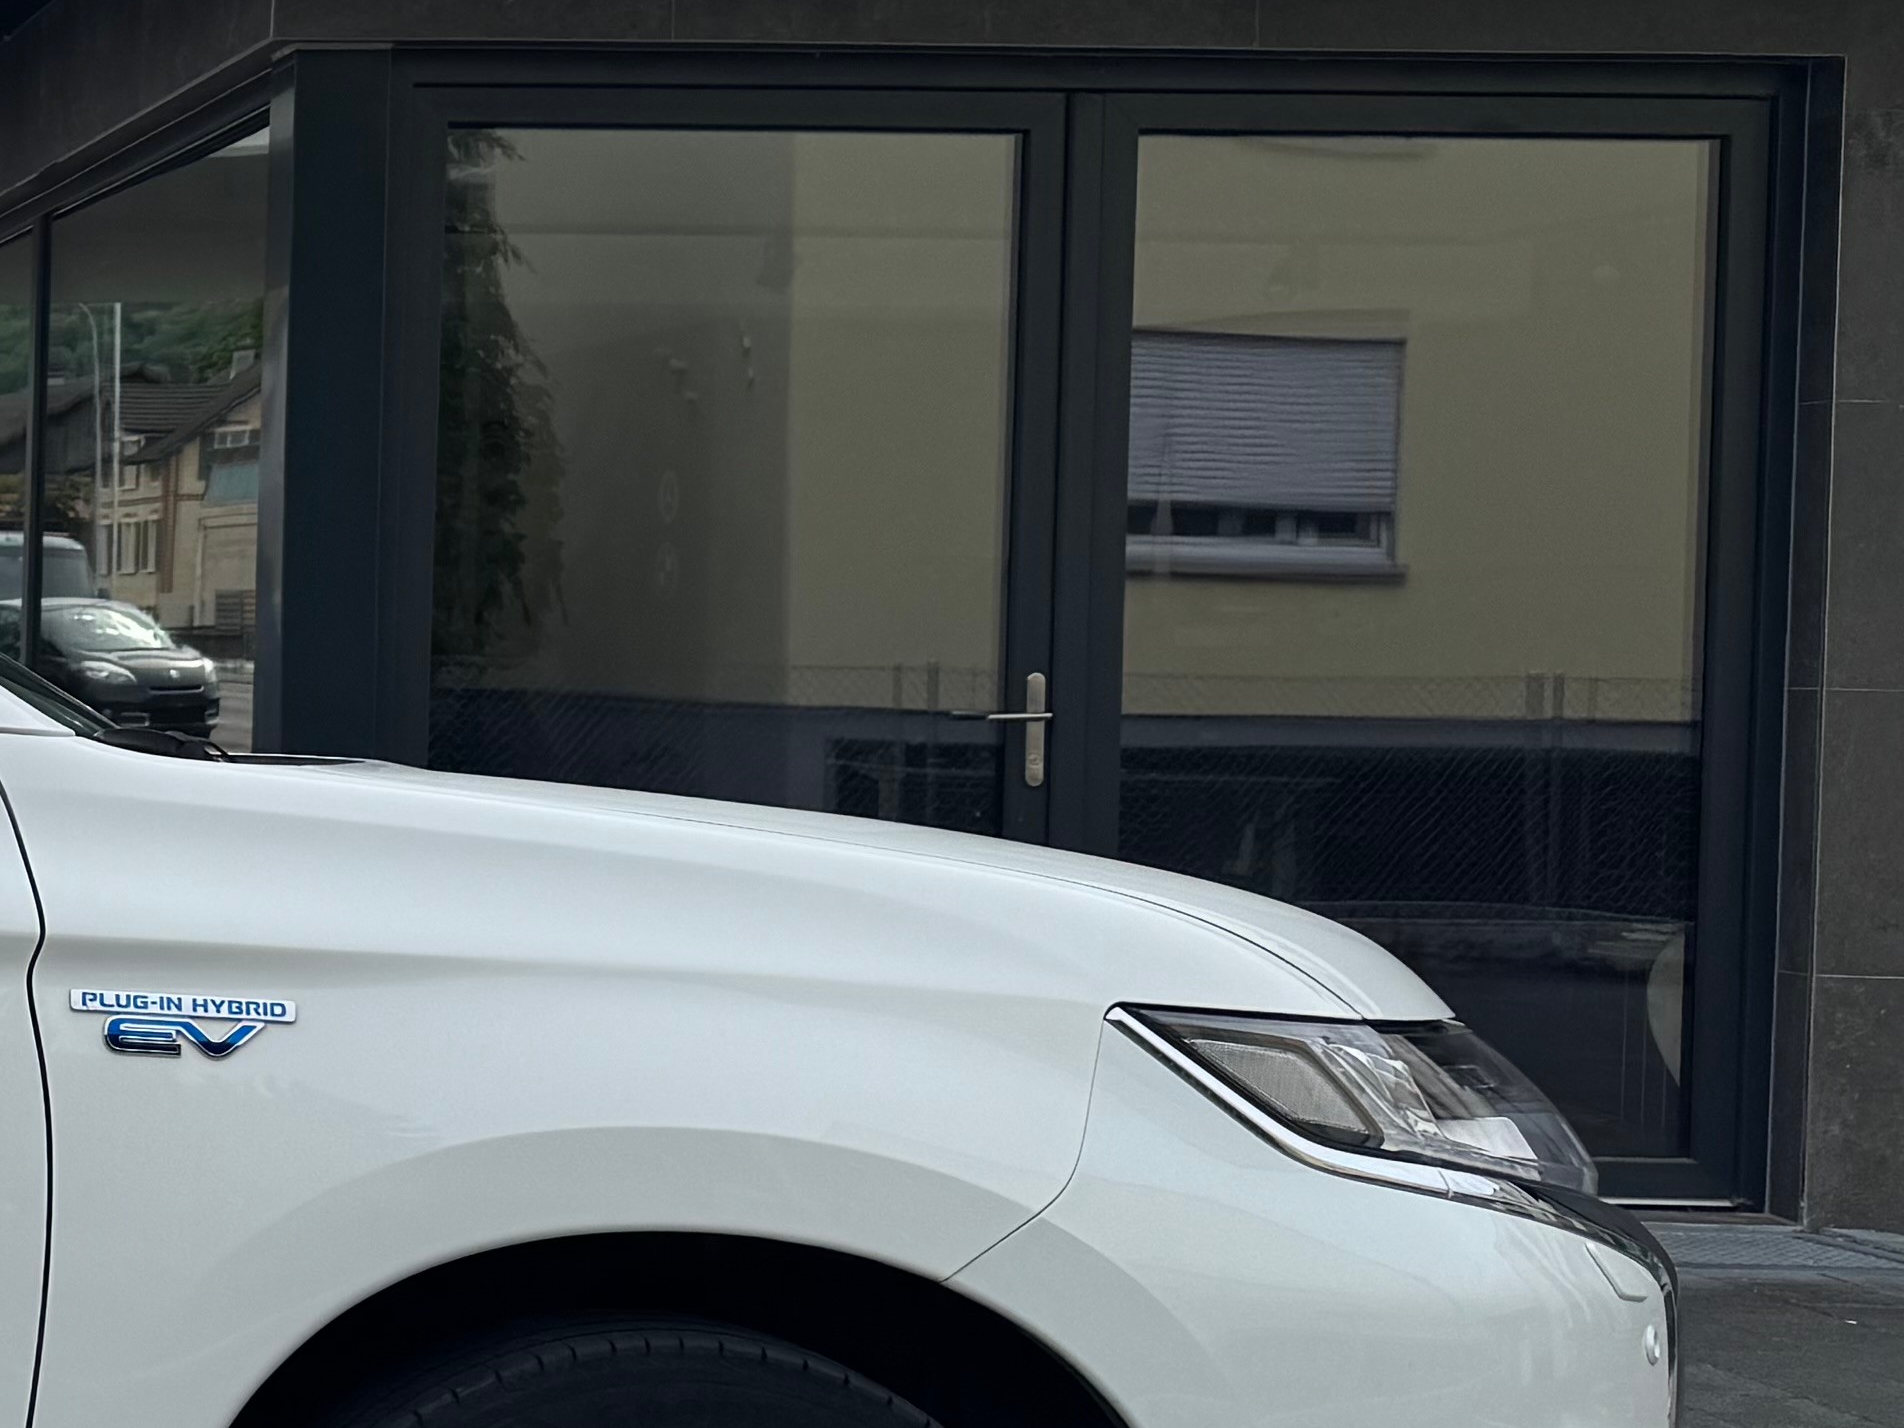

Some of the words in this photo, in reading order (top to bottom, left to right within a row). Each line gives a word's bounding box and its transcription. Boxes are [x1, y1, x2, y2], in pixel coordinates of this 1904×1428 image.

[81, 991, 183, 1012] PLUG-IN
[192, 998, 287, 1018] HYBRID
[103, 1014, 266, 1059] EV
